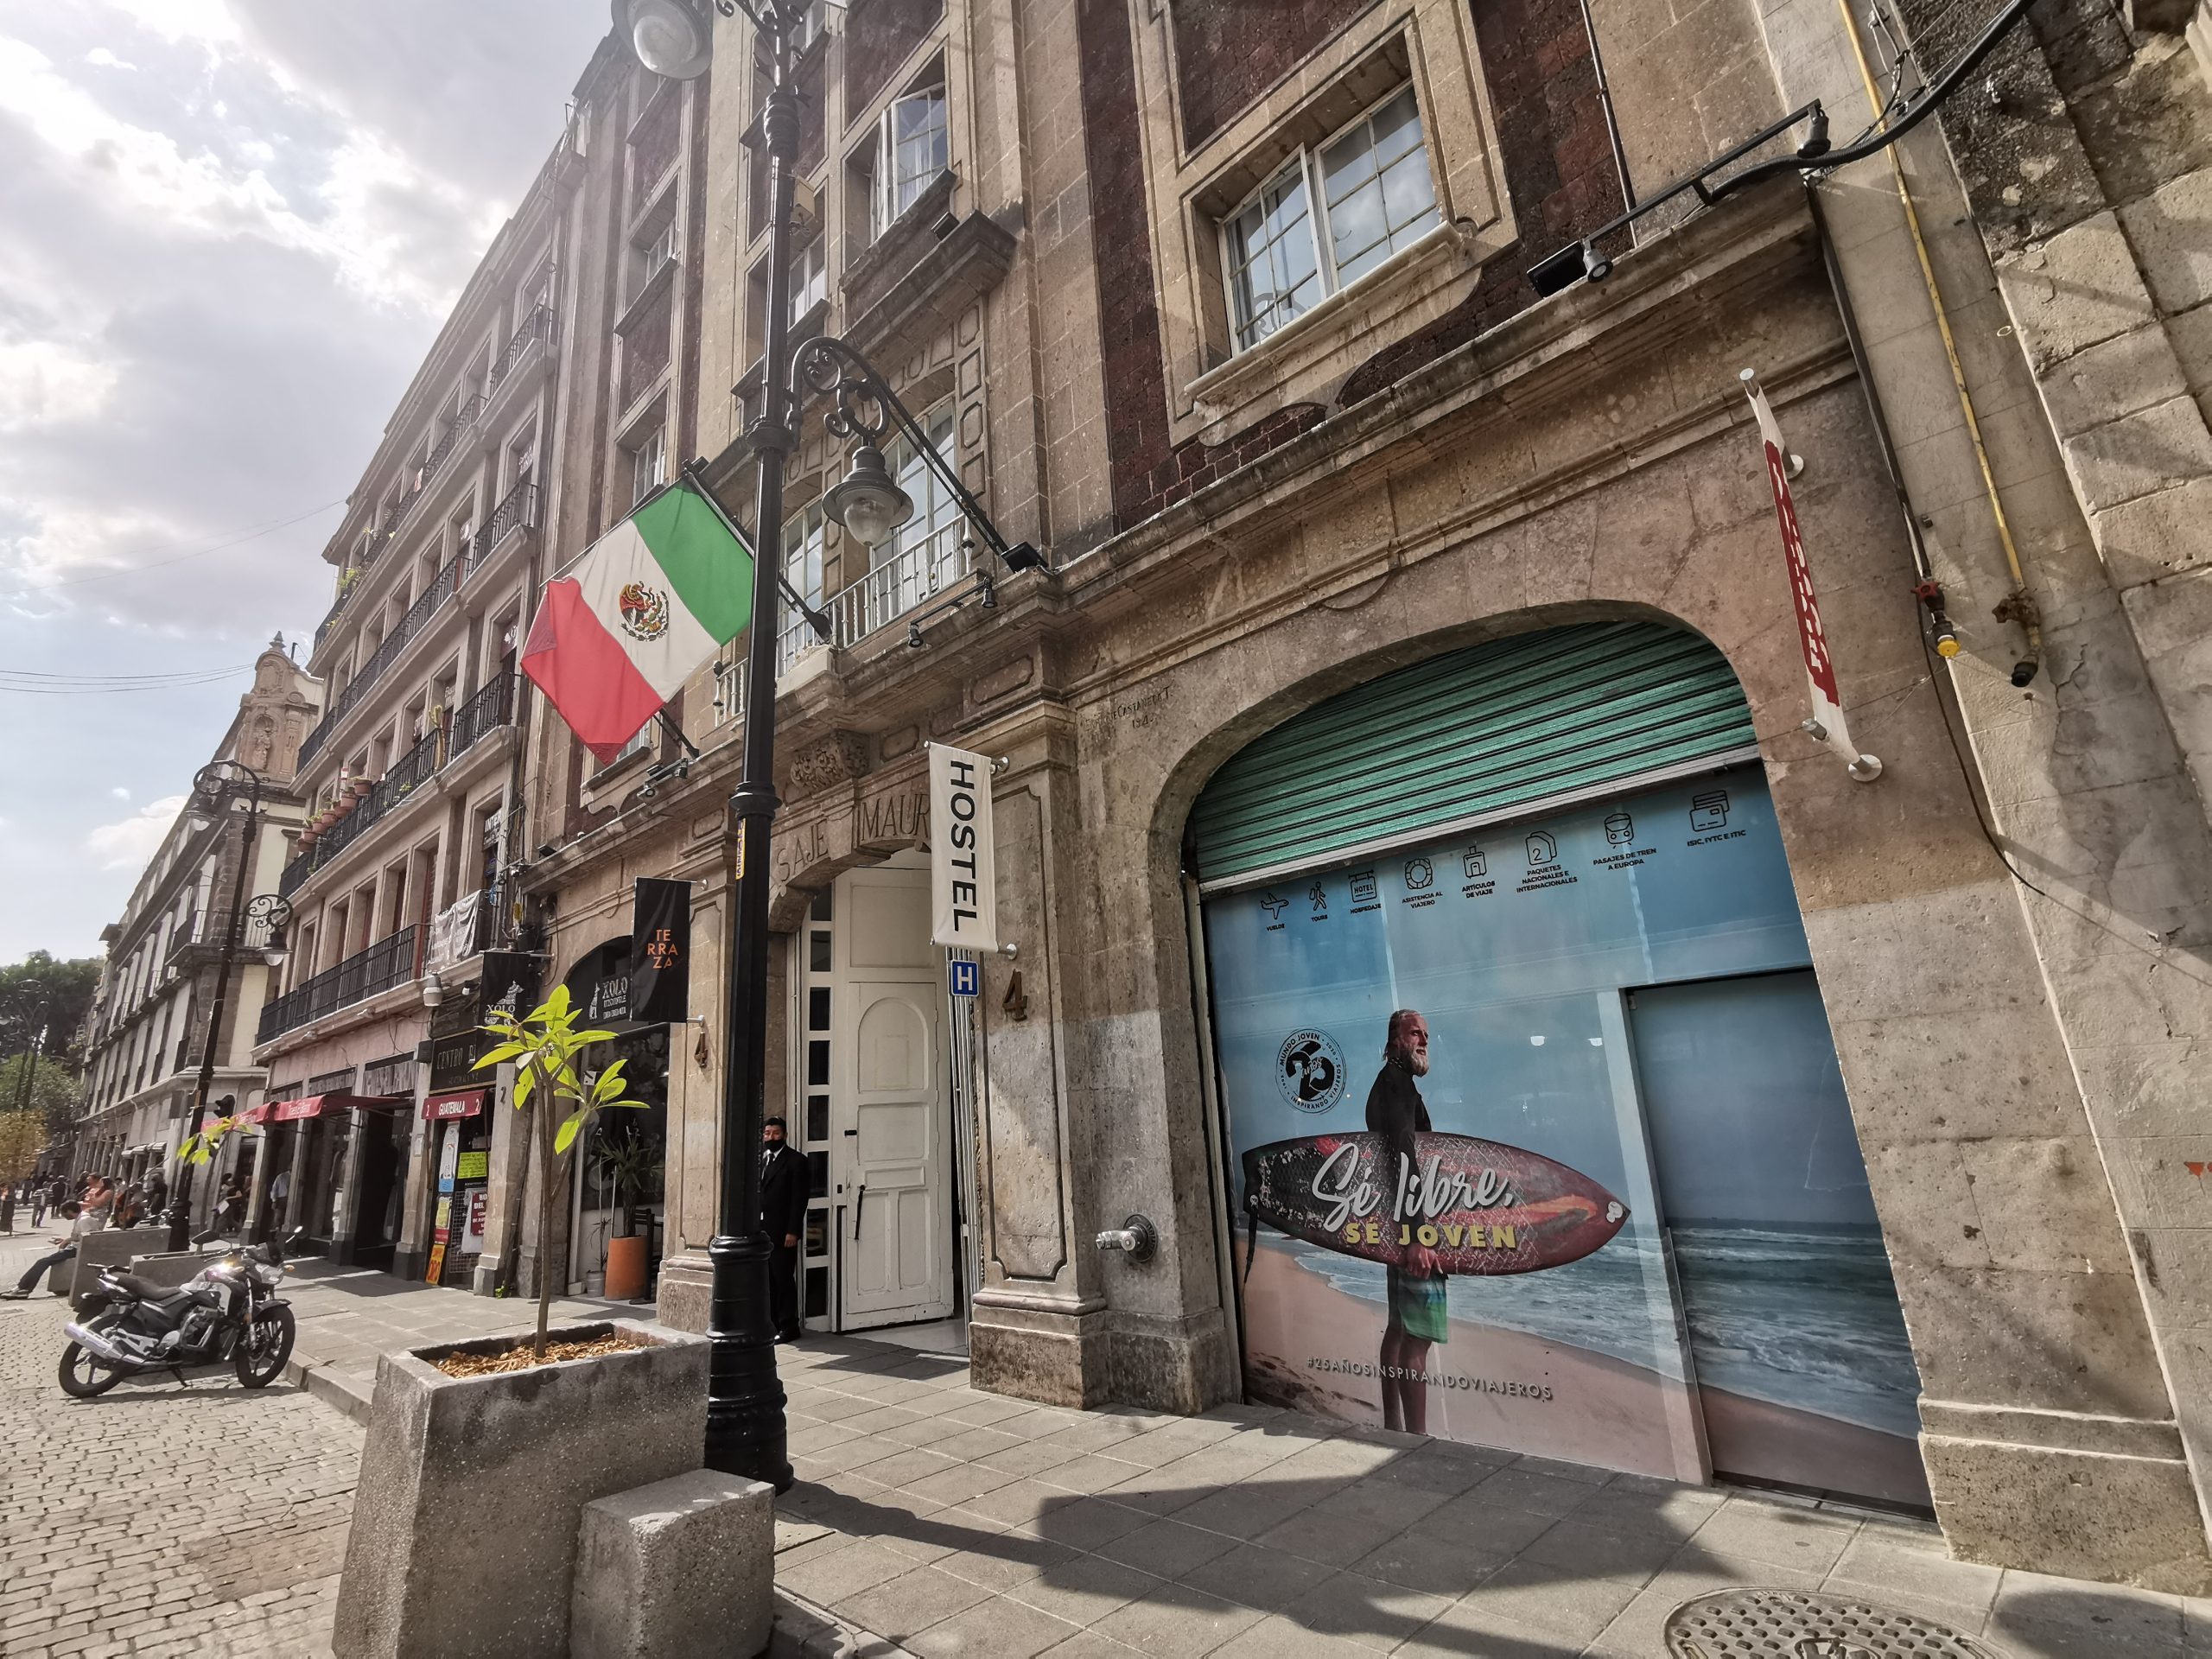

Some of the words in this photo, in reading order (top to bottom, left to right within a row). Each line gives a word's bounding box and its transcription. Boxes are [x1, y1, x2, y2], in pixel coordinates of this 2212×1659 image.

[861, 792, 931, 842] MAUR
[950, 760, 978, 932] HOSTEL
[1592, 853, 1625, 866] PASAJES
[1625, 850, 1637, 859] DE
[1636, 848, 1657, 856] TREN
[1614, 858, 1645, 870] EUROPA
[1527, 863, 1561, 876] PAQUETES
[1516, 876, 1578, 893] INTERNACIONALES
[1522, 872, 1564, 885] NACIONALES
[1353, 884, 1375, 894] HOTEL
[1476, 888, 1494, 898] VIAJE
[1402, 893, 1435, 904] ASISTENCIA
[1409, 899, 1436, 909] VIAJERO
[1350, 903, 1382, 915] HOSPEDAJE
[656, 929, 671, 942] TE
[646, 943, 678, 956] RRA
[652, 956, 673, 969] ZA
[957, 965, 973, 992] H
[602, 976, 628, 1000] XOLO
[1001, 968, 1027, 1021] 4
[486, 1004, 516, 1013] XOLO
[1279, 1039, 1296, 1066] MUNDO
[1297, 1032, 1320, 1041] JOVEN
[1290, 1095, 1329, 1109] INSPIRANDO
[1329, 1064, 1342, 1099] VIAJEROS
[499, 1086, 507, 1104] 2
[438, 1100, 466, 1116] GUATEMALA
[1312, 1142, 1382, 1233] Sé
[1393, 1151, 1513, 1224] libre,
[1397, 1224, 1518, 1249] JOVEN
[1306, 1355, 1554, 1401] #25AÑOSINSPIRANDOVIAJEROS
